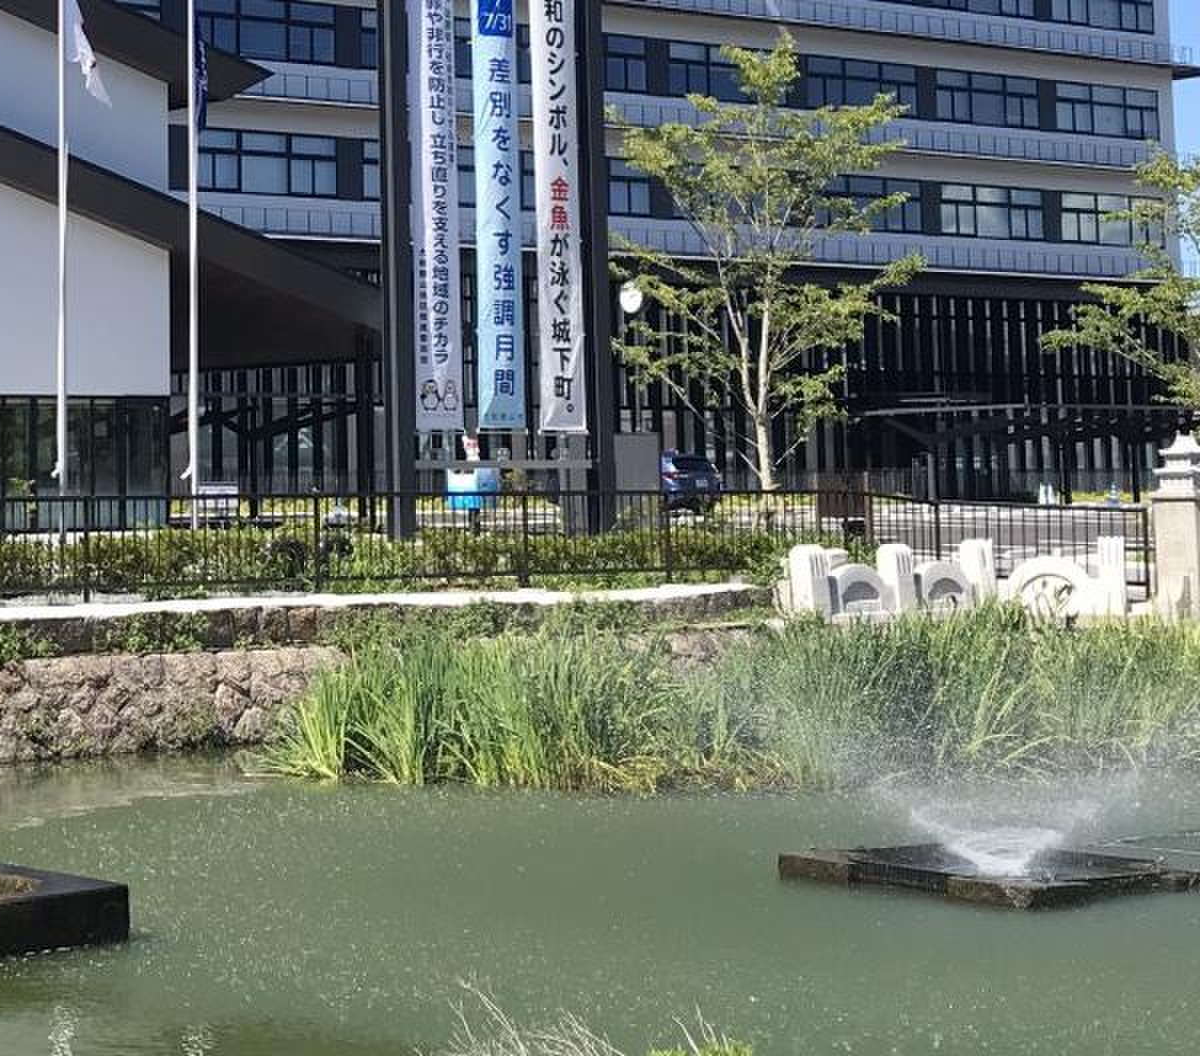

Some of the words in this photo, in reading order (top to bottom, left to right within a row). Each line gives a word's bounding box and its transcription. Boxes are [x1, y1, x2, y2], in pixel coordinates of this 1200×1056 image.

[482, 13, 512, 31] 7/31
[488, 58, 515, 396] 差別をなくす強調月間
